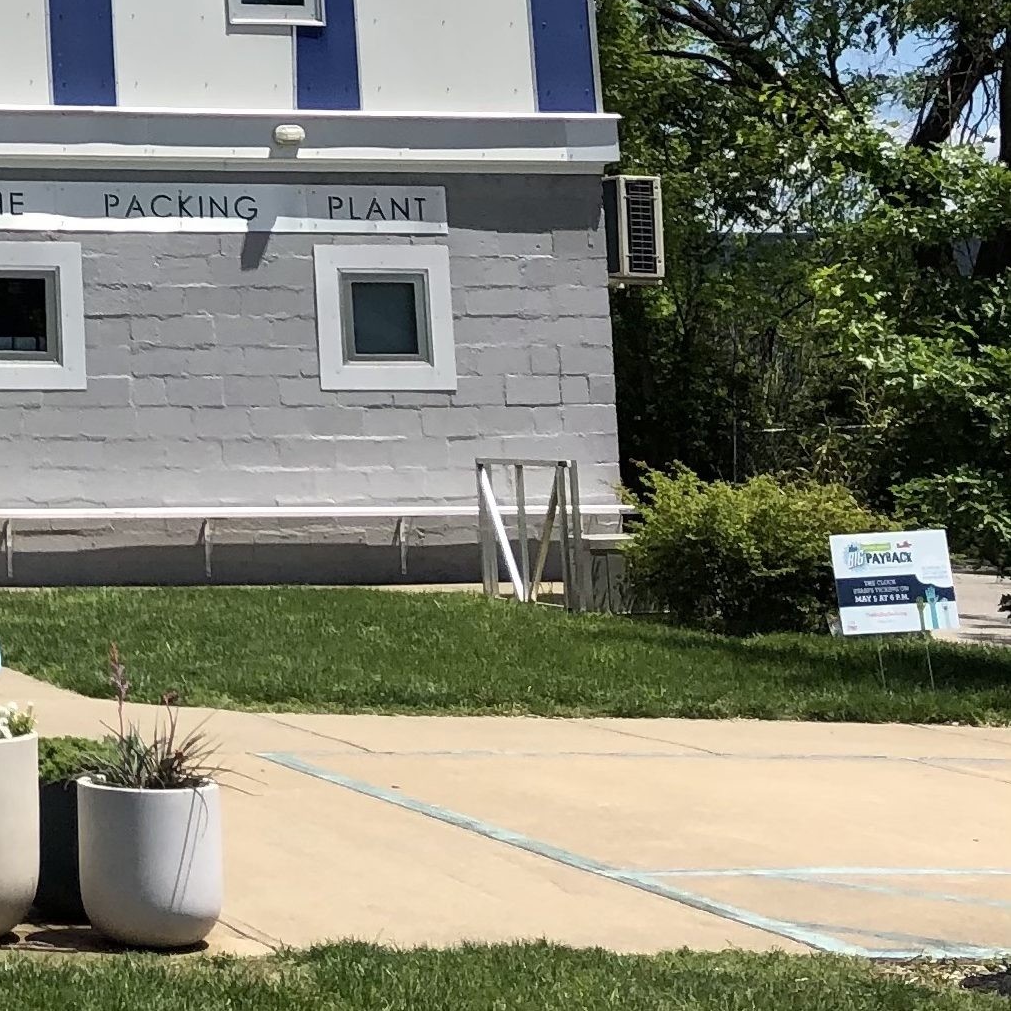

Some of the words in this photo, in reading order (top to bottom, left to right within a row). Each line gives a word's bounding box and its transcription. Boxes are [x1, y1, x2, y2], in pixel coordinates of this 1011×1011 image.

[103, 194, 258, 221] PACKING
[328, 196, 427, 221] PLANT
[849, 550, 865, 568] BIG
[866, 551, 913, 565] PAYBACK
[855, 595, 871, 603] MAY
[879, 594, 888, 602] AT
